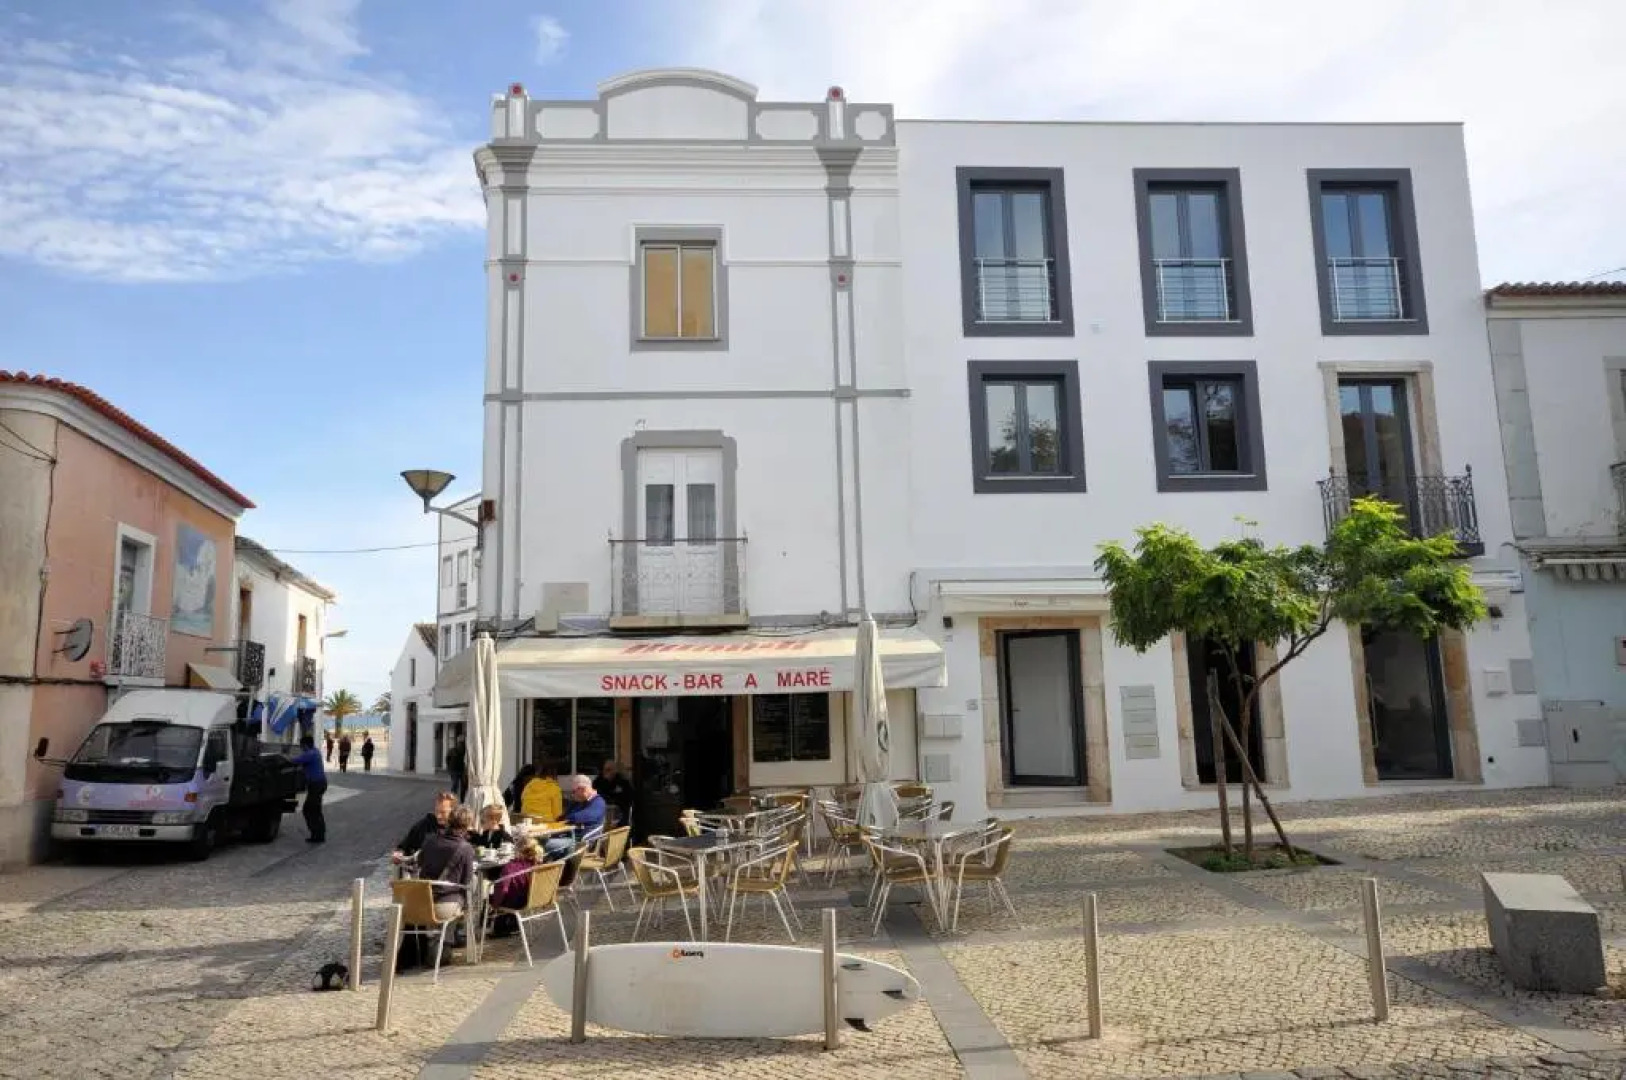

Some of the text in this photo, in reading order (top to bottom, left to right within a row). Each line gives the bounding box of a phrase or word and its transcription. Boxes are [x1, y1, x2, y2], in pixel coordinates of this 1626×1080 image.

[601, 674, 668, 691] SNACK
[683, 673, 723, 689] BAR
[744, 672, 758, 688] A
[777, 667, 832, 687] MARÉ
